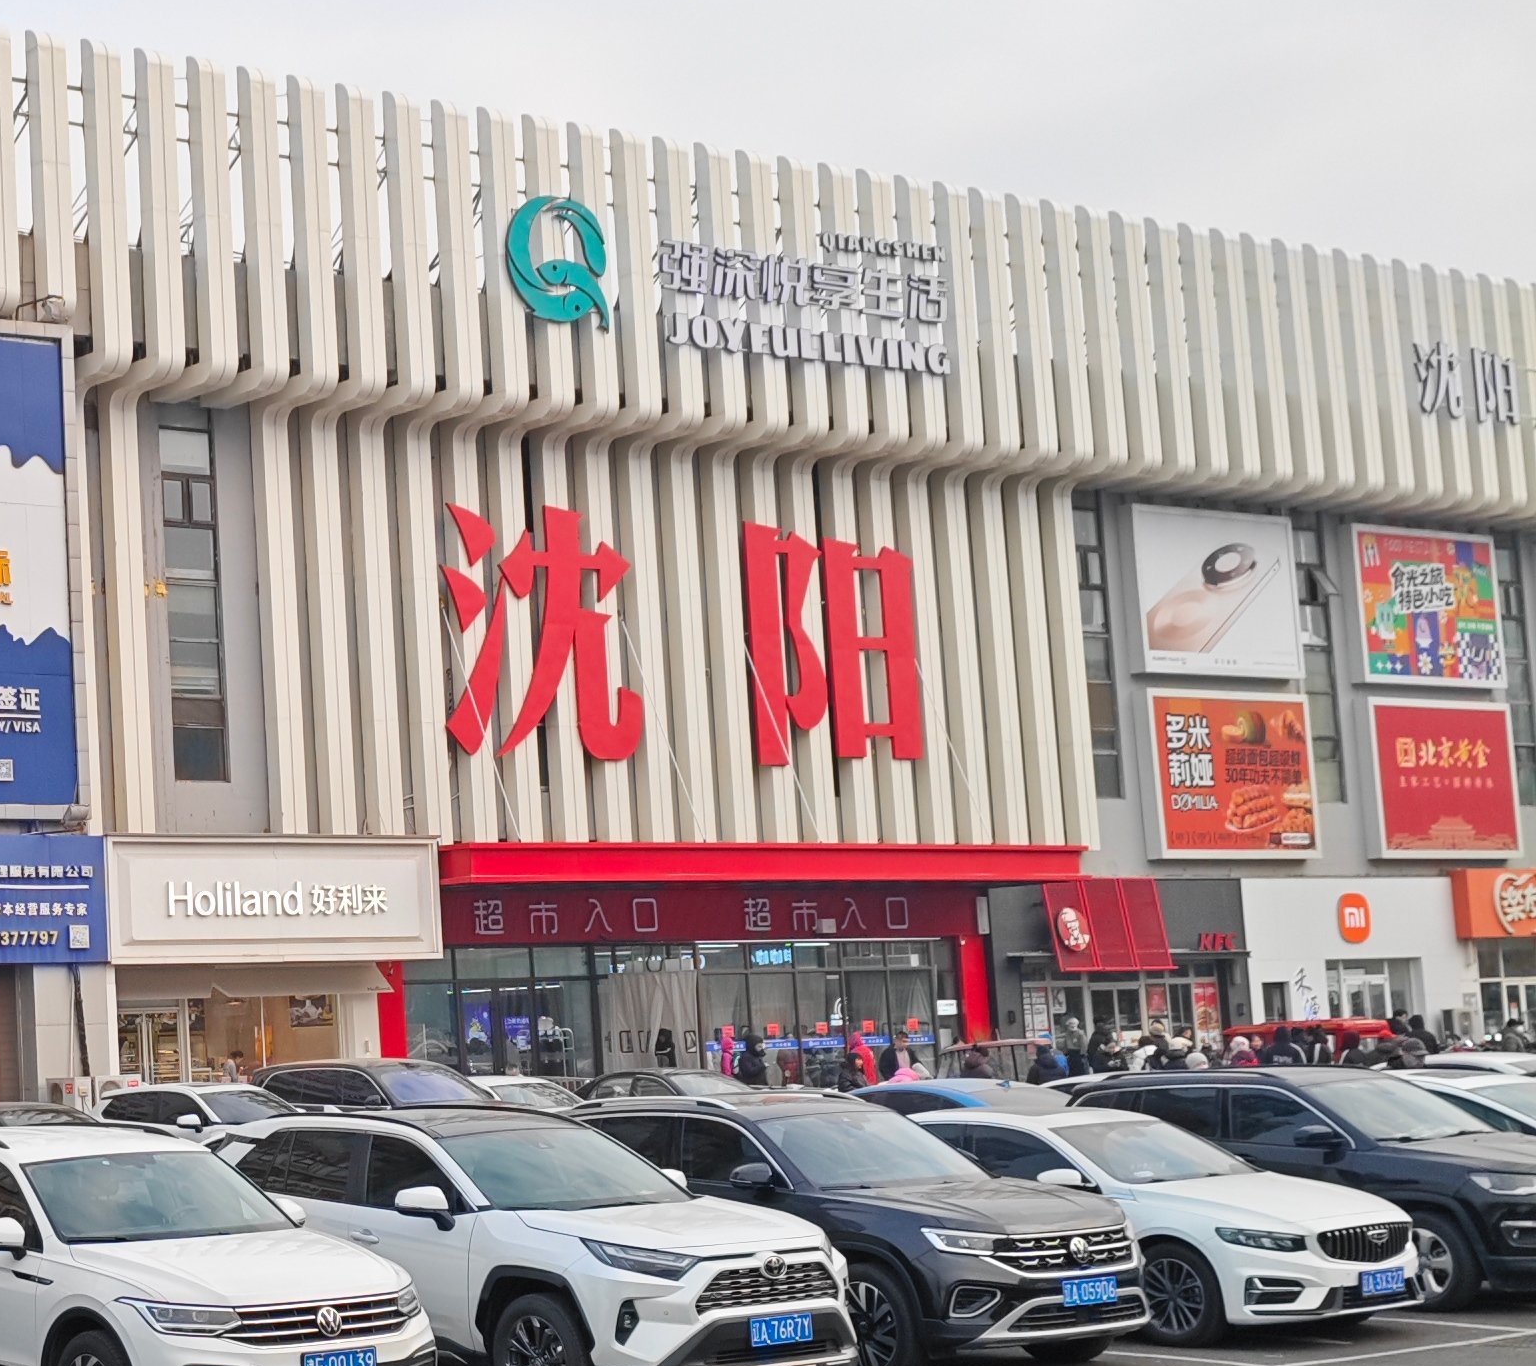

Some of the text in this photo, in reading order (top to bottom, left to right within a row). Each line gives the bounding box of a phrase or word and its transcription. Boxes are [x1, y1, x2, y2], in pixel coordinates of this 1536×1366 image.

[820, 232, 947, 263] QIANGSHEN
[659, 239, 948, 323] 强深悦享生活
[1412, 341, 1520, 425] 沈阳
[439, 502, 923, 766] 沈阳
[12, 720, 41, 734] VISA
[1166, 713, 1211, 750] 多米
[1168, 752, 1214, 788] 莉娅
[168, 881, 388, 917] Holiland 好利来
[473, 896, 659, 935] 超市入口
[743, 896, 910, 932] 超市入口
[1199, 932, 1237, 952] KFC
